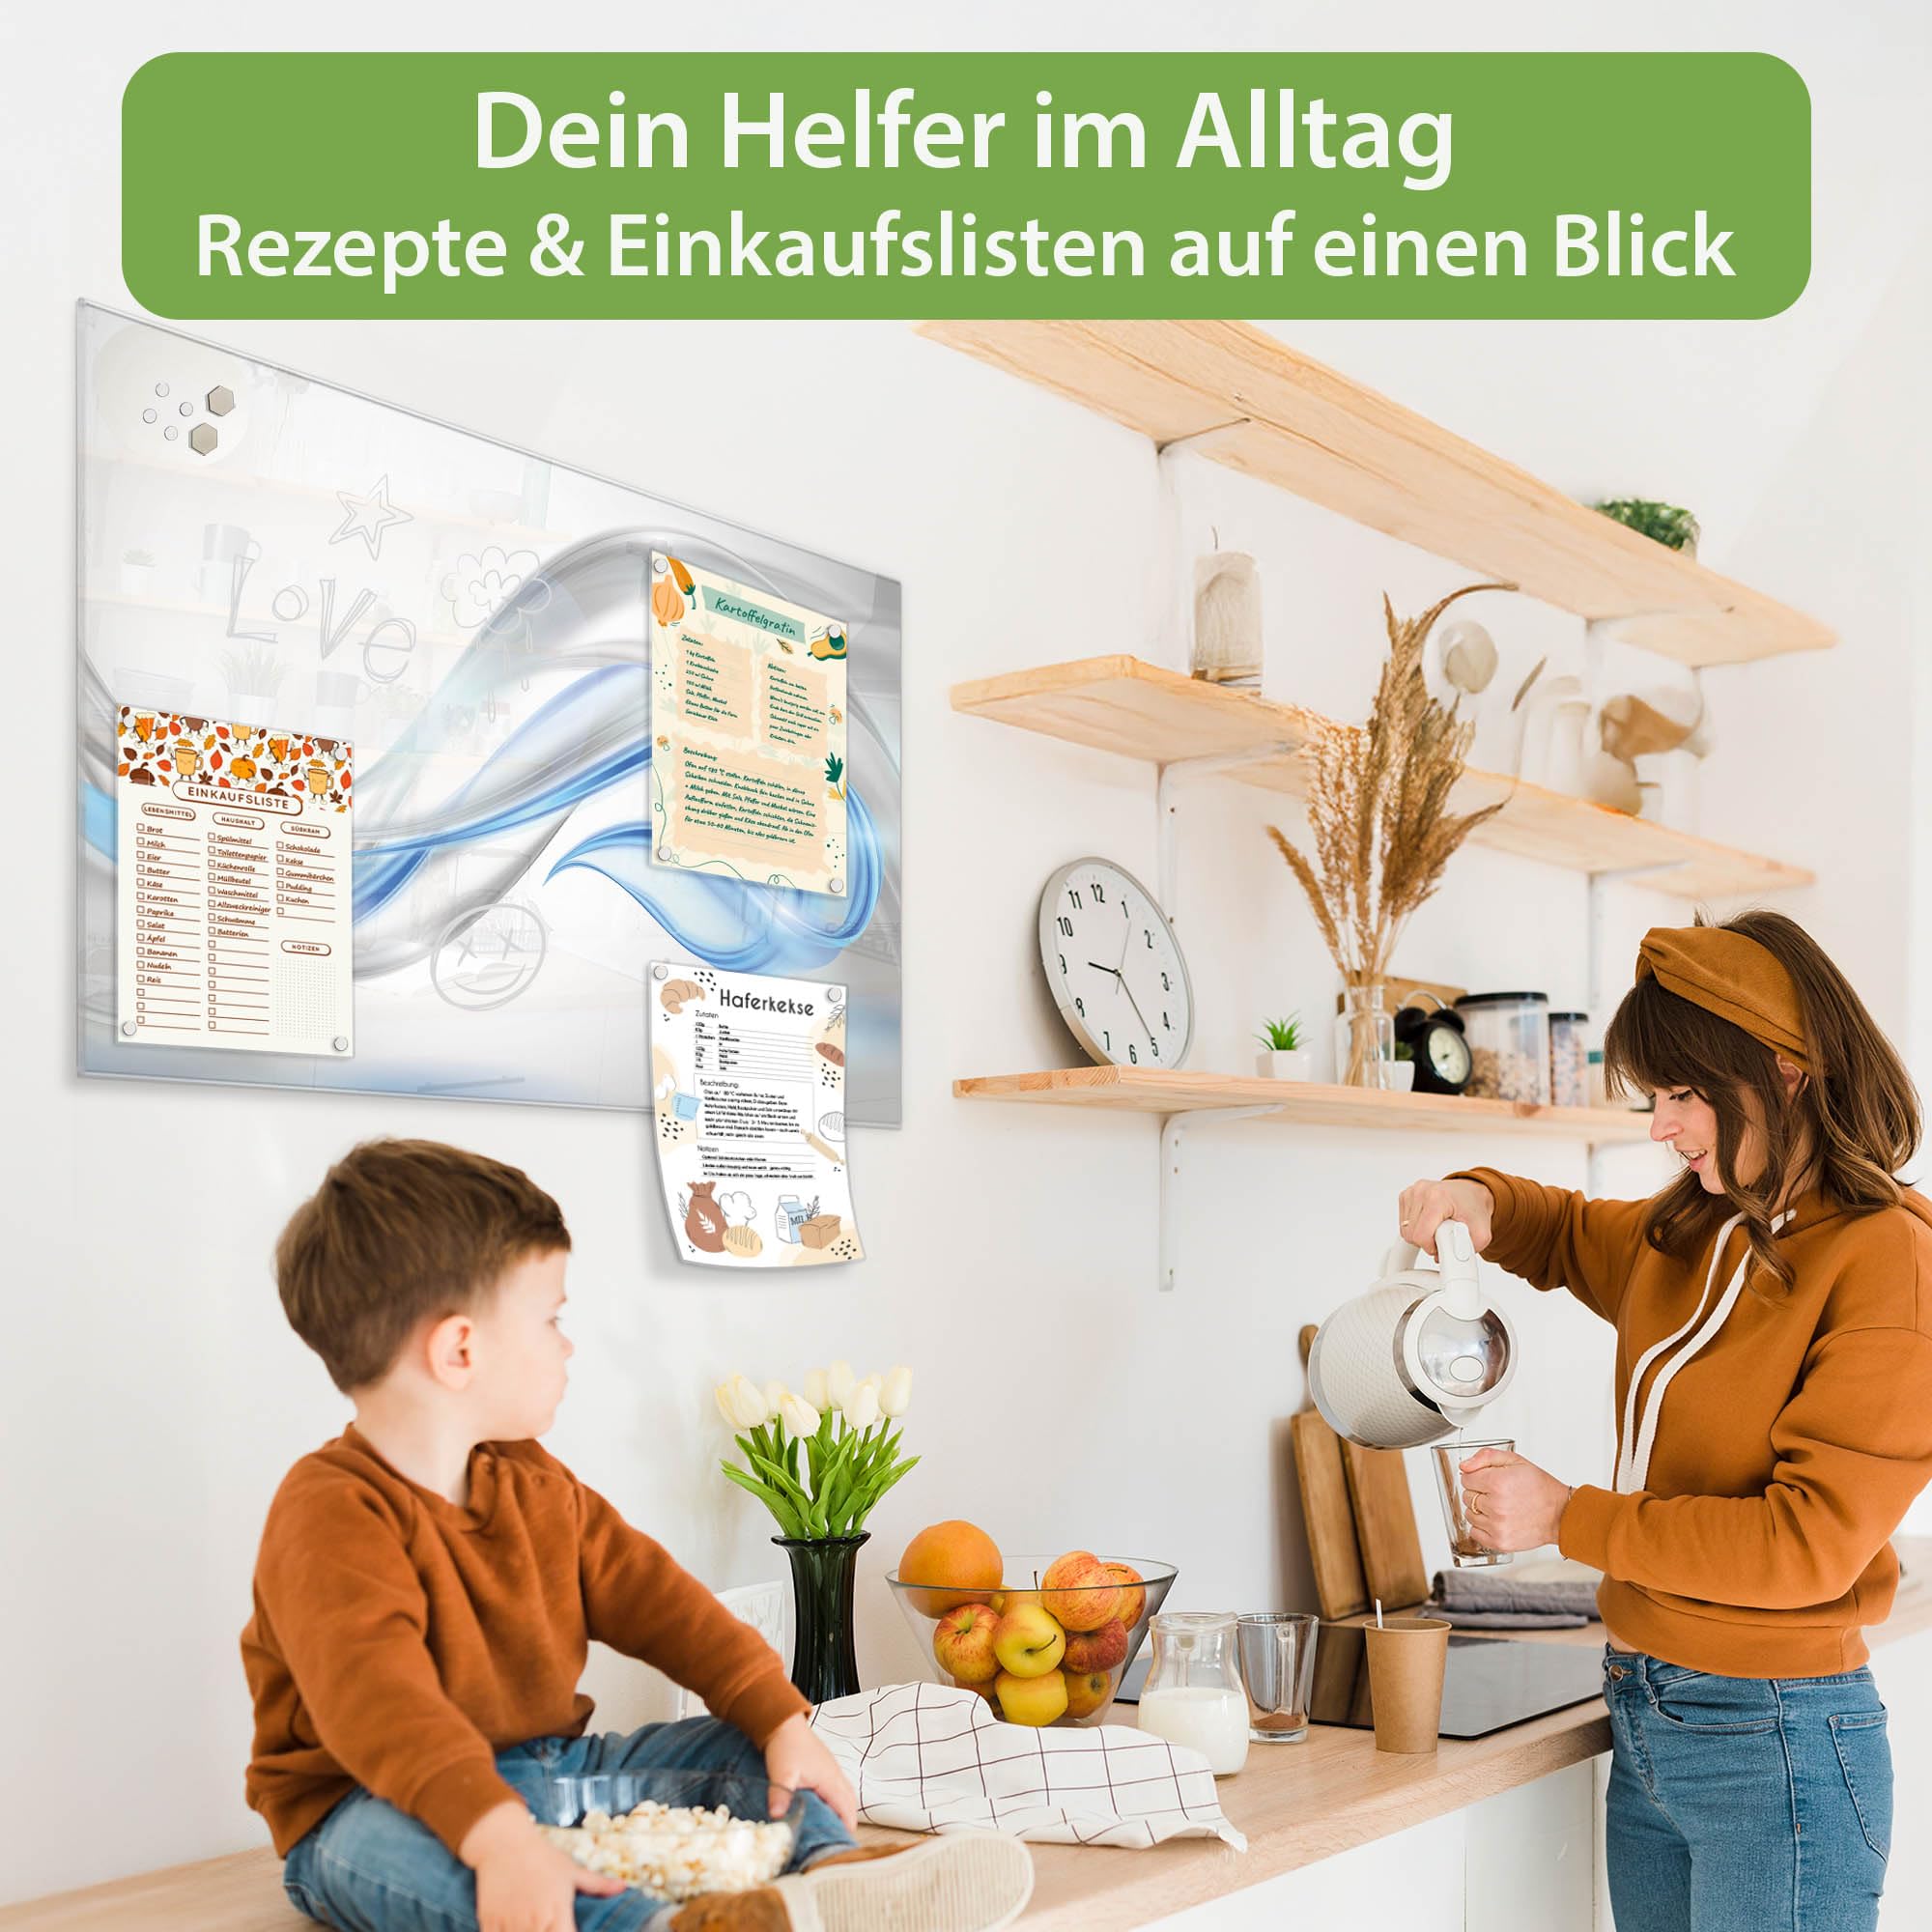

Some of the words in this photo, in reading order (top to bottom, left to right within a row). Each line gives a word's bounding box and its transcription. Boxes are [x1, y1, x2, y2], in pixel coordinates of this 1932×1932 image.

[715, 597, 796, 637] Kartoffelgratin
[187, 786, 289, 810] EINKAUFSLISTE
[144, 806, 193, 819] LEBENSMITTEL
[221, 816, 255, 826] HAUSHALT
[217, 835, 252, 845] Spülmittel
[286, 843, 321, 854] Schokolade
[217, 849, 268, 862] Toilettenpapier
[286, 857, 303, 866] Kekse
[217, 863, 256, 872] Küchenrolle
[217, 875, 251, 885] Müllbeutel
[286, 870, 334, 882] Gummibärchen
[217, 889, 259, 898] Waschmittel
[286, 883, 312, 894] Pudding
[1091, 884, 1105, 903] 12
[147, 895, 179, 903] Karotten
[286, 896, 309, 905] Kuchen
[1068, 890, 1083, 910] 11
[147, 908, 174, 917] Paprika
[217, 902, 271, 913] Allzweckreiniger
[1121, 900, 1128, 919] 1
[1057, 917, 1074, 937] 10
[217, 928, 249, 938] Batterien
[1144, 929, 1153, 950] 2
[147, 949, 178, 957] Bananen
[292, 944, 320, 952] NOTIZEN
[1161, 972, 1170, 991] 3
[721, 989, 814, 1016] Haferkekse
[696, 1010, 719, 1019] Zutaten
[1103, 1031, 1110, 1051] 7
[1151, 1037, 1158, 1057] 5
[1129, 1044, 1137, 1065] 6
